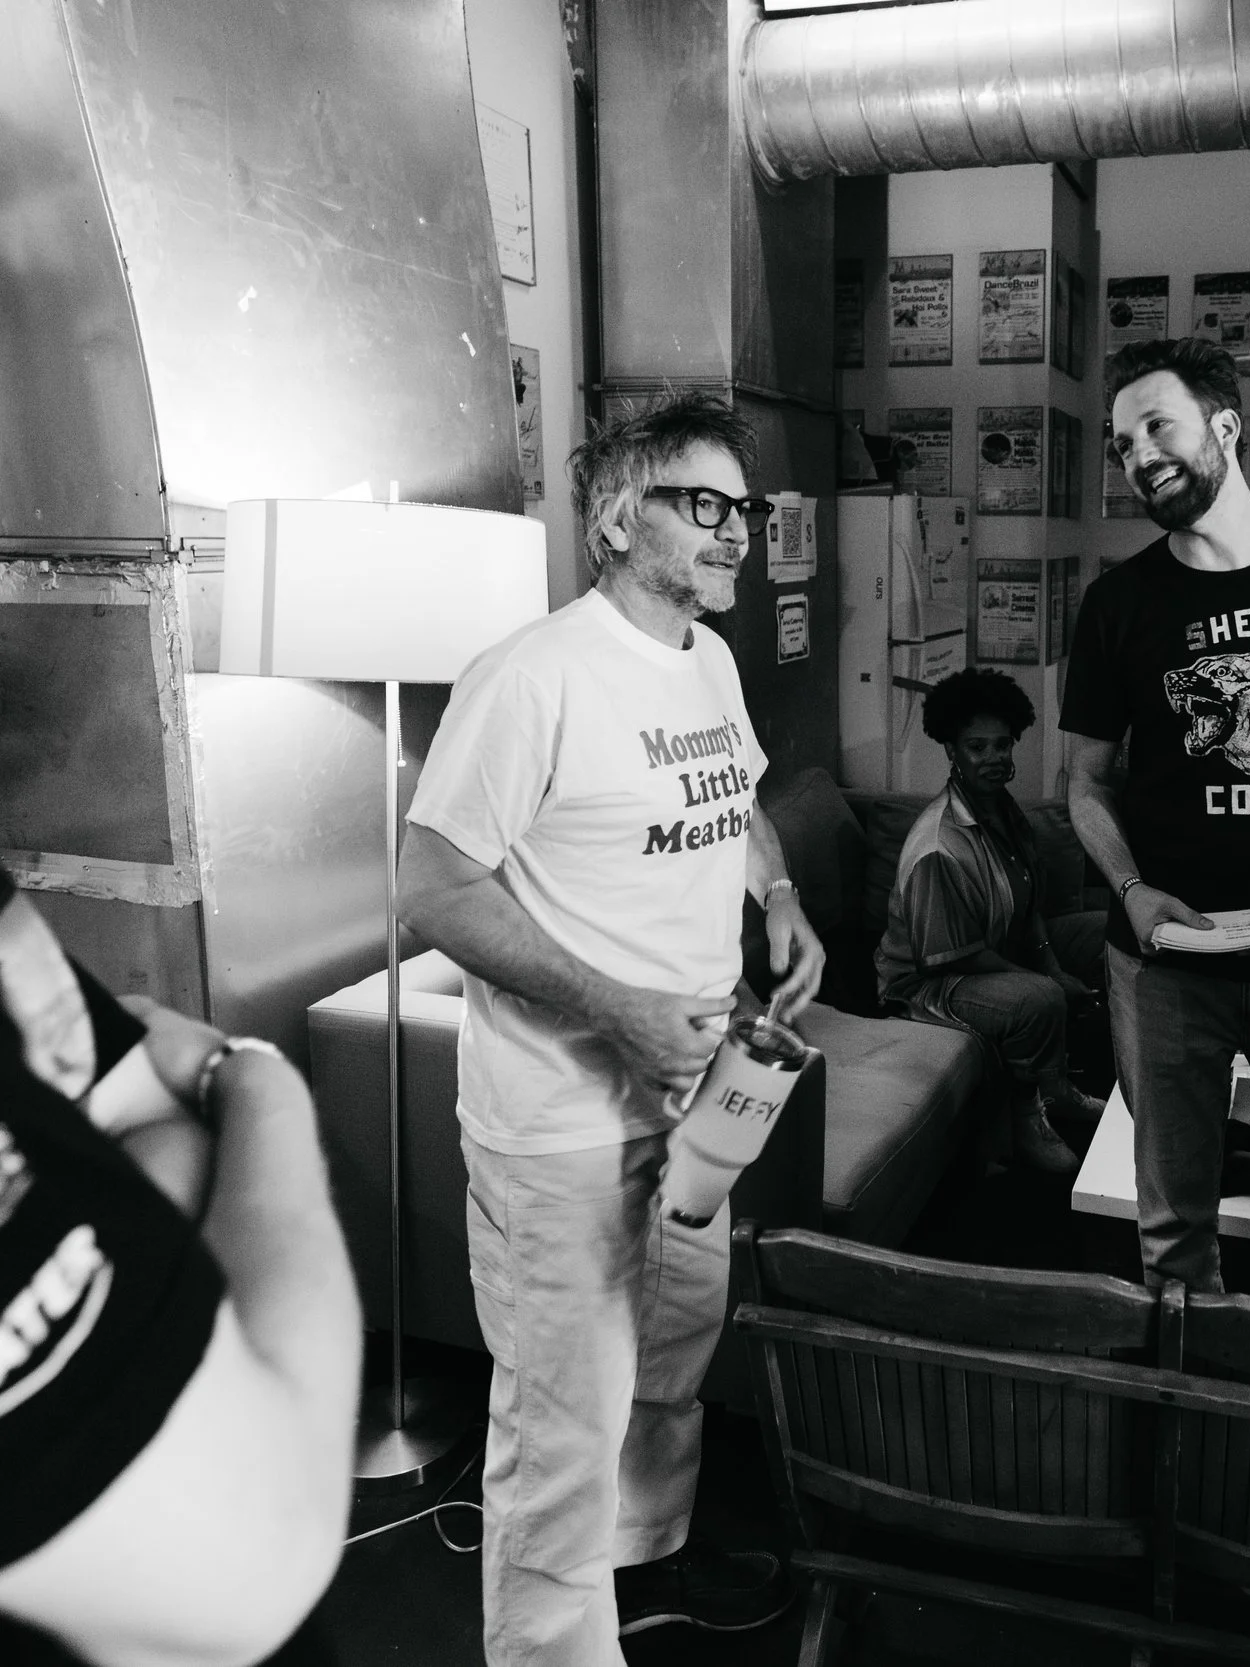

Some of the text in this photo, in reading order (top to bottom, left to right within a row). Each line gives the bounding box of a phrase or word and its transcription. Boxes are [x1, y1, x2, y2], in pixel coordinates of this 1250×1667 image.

[892, 286, 913, 294] Sara
[984, 278, 1039, 289] DanceBrazil
[639, 714, 742, 769] Mommy's
[679, 763, 749, 808] Little
[718, 1086, 781, 1124] JEFFY
